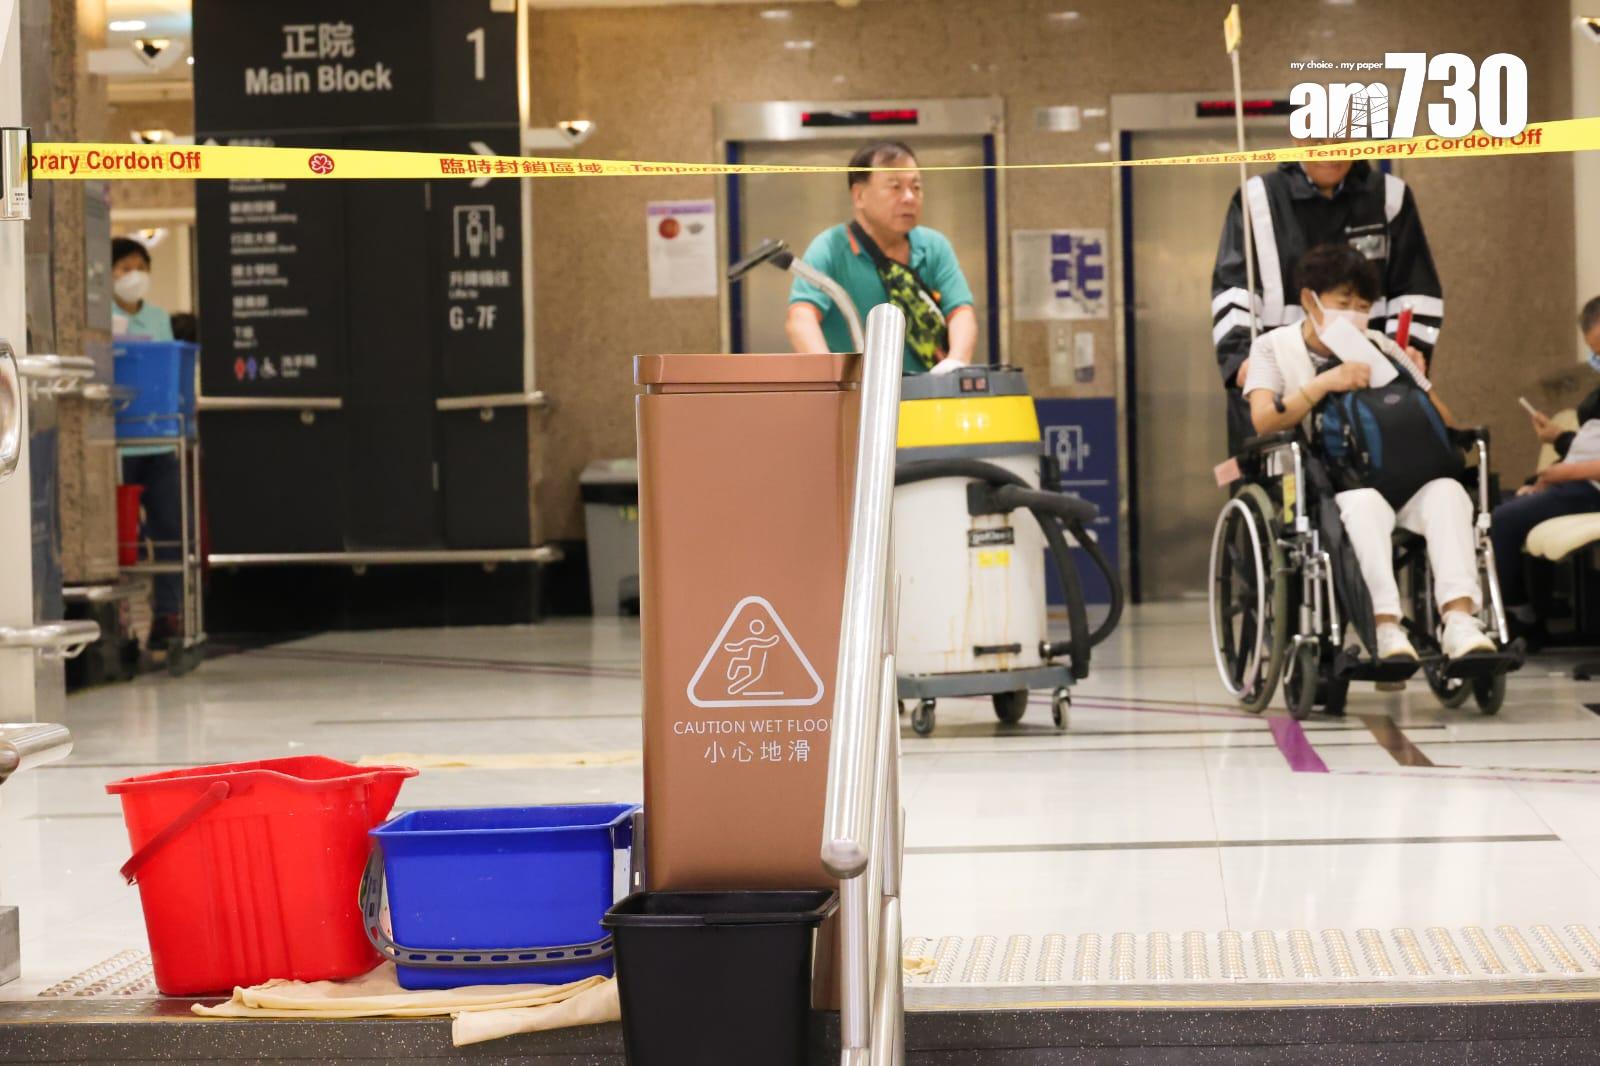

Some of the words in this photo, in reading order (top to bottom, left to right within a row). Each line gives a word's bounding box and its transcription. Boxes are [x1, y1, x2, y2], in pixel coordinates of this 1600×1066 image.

[281, 20, 355, 60] 正院
[466, 27, 486, 81] 1
[245, 66, 311, 95] Main
[317, 61, 392, 93] Block
[1305, 141, 1418, 158] Temporary
[1425, 132, 1503, 151] Cordon
[1510, 127, 1543, 146] Off
[86, 150, 163, 170] Cordon
[169, 151, 201, 170] Off
[439, 158, 603, 175] 臨時封鎖區域
[629, 163, 743, 174] Temporary
[673, 719, 745, 735] CAUTION
[750, 719, 783, 733] WET
[787, 718, 832, 733] FLOO
[703, 739, 811, 764] 小心地滑
